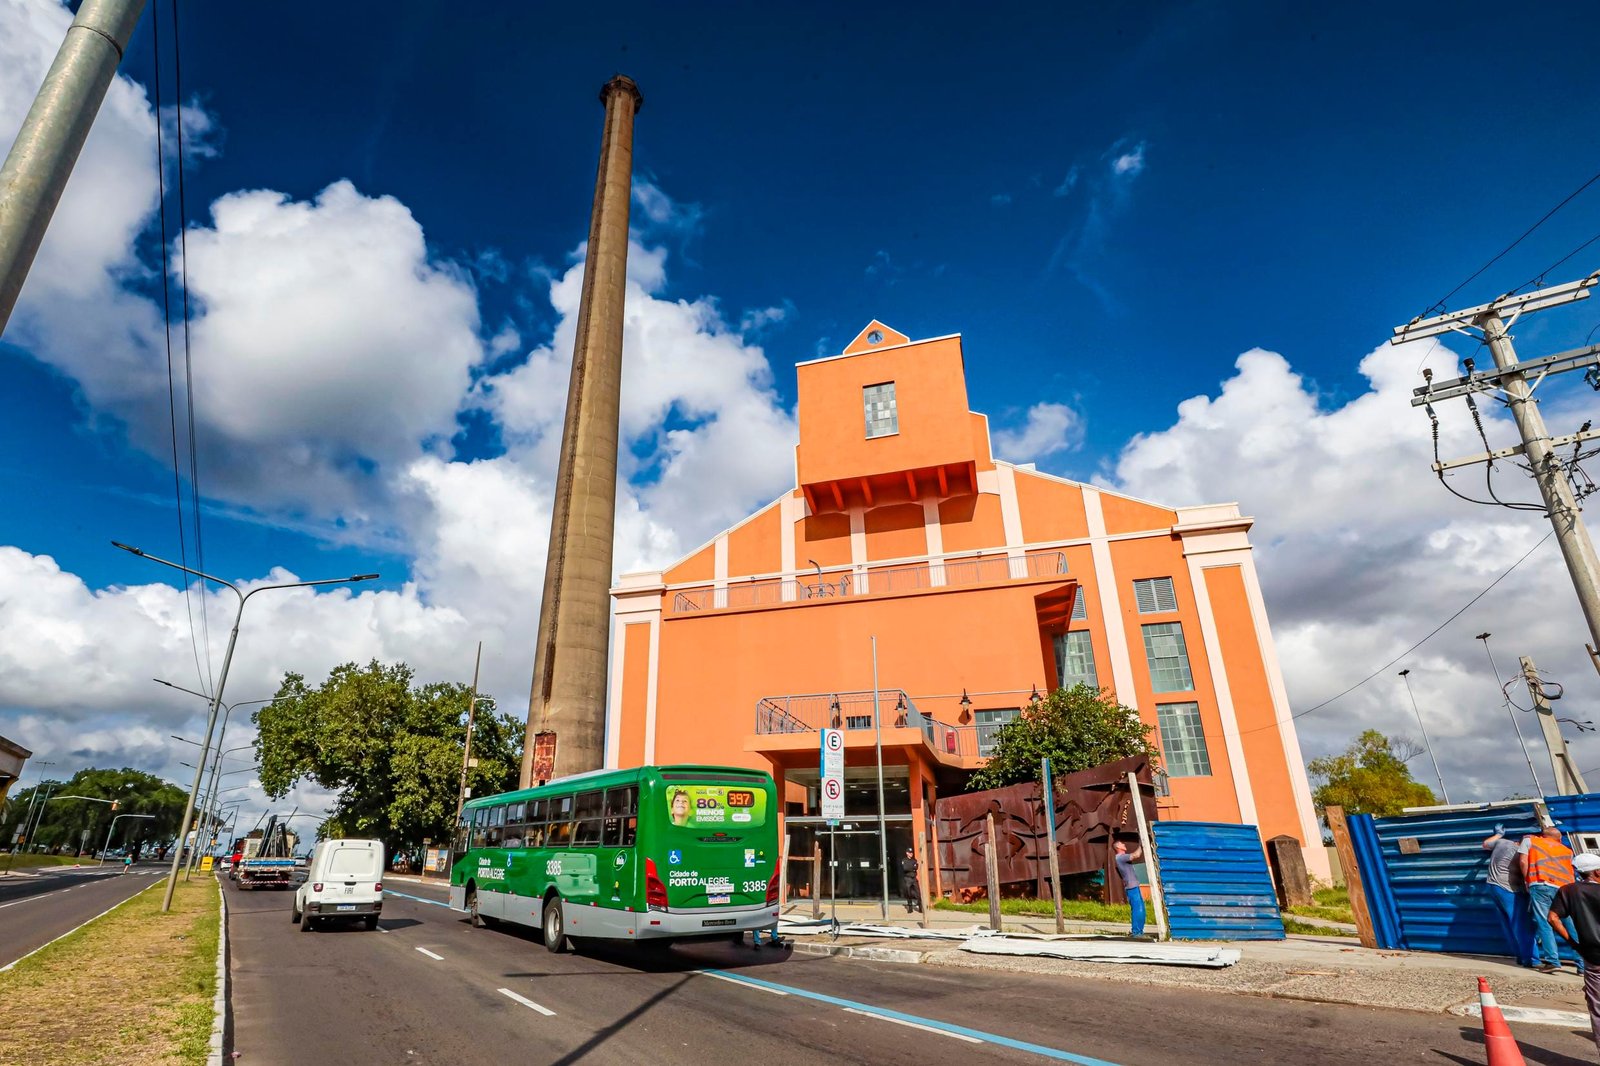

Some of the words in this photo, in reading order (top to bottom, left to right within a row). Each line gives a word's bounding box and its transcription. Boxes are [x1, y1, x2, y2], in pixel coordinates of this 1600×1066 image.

[831, 736, 838, 747] E
[729, 793, 751, 805] 397
[546, 860, 562, 875] 3385
[490, 868, 505, 880] ALEGRE
[669, 878, 698, 887] PORTO
[698, 877, 730, 886] ALEGRE
[742, 880, 767, 893] 3385
